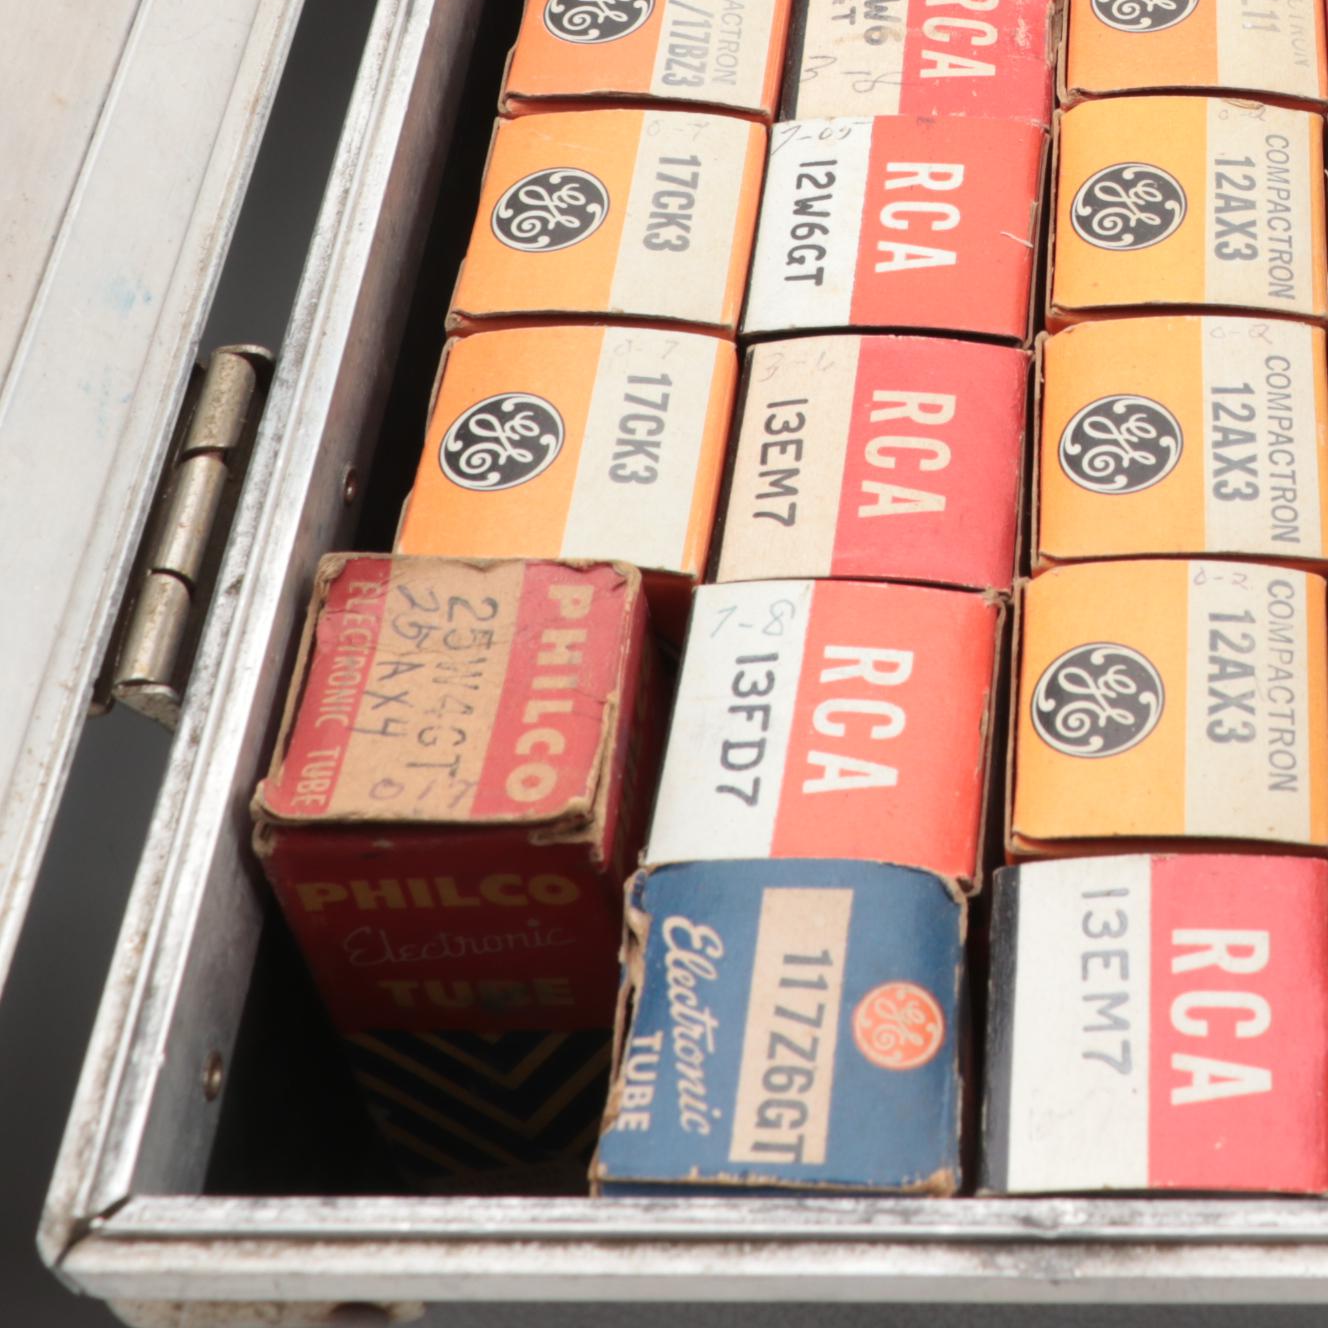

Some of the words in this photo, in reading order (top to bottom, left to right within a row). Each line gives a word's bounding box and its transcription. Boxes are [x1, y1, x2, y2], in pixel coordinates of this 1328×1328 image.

[643, 154, 702, 253] 17CK3
[782, 159, 839, 287] 12W6GT
[872, 162, 965, 274] RCA
[1213, 154, 1258, 263] 12AX3
[1264, 134, 1295, 300] COMPACTRON
[608, 374, 674, 486] 17CK3
[752, 397, 809, 528] 13EM7
[857, 389, 957, 518] RCA
[1211, 381, 1259, 503] 12AX3
[1264, 355, 1301, 543] COMPACTRON
[314, 580, 384, 730] ELECTRONIC
[504, 583, 595, 803] PHILCO
[802, 645, 914, 795] RCA
[1206, 610, 1256, 745] 12AX3
[1266, 579, 1298, 794] COMPACTRON
[291, 746, 341, 808] TUBE
[715, 651, 780, 807] 13FD7
[295, 875, 582, 910] PHILCO
[345, 919, 577, 967] Electronic
[379, 978, 576, 1008] TUBE
[660, 916, 724, 1136] Electronic
[1081, 888, 1132, 1076] 13EM7
[1170, 929, 1273, 1106] RCA
[617, 1031, 661, 1132] TUBE
[749, 948, 834, 1163] 117Z6GT
